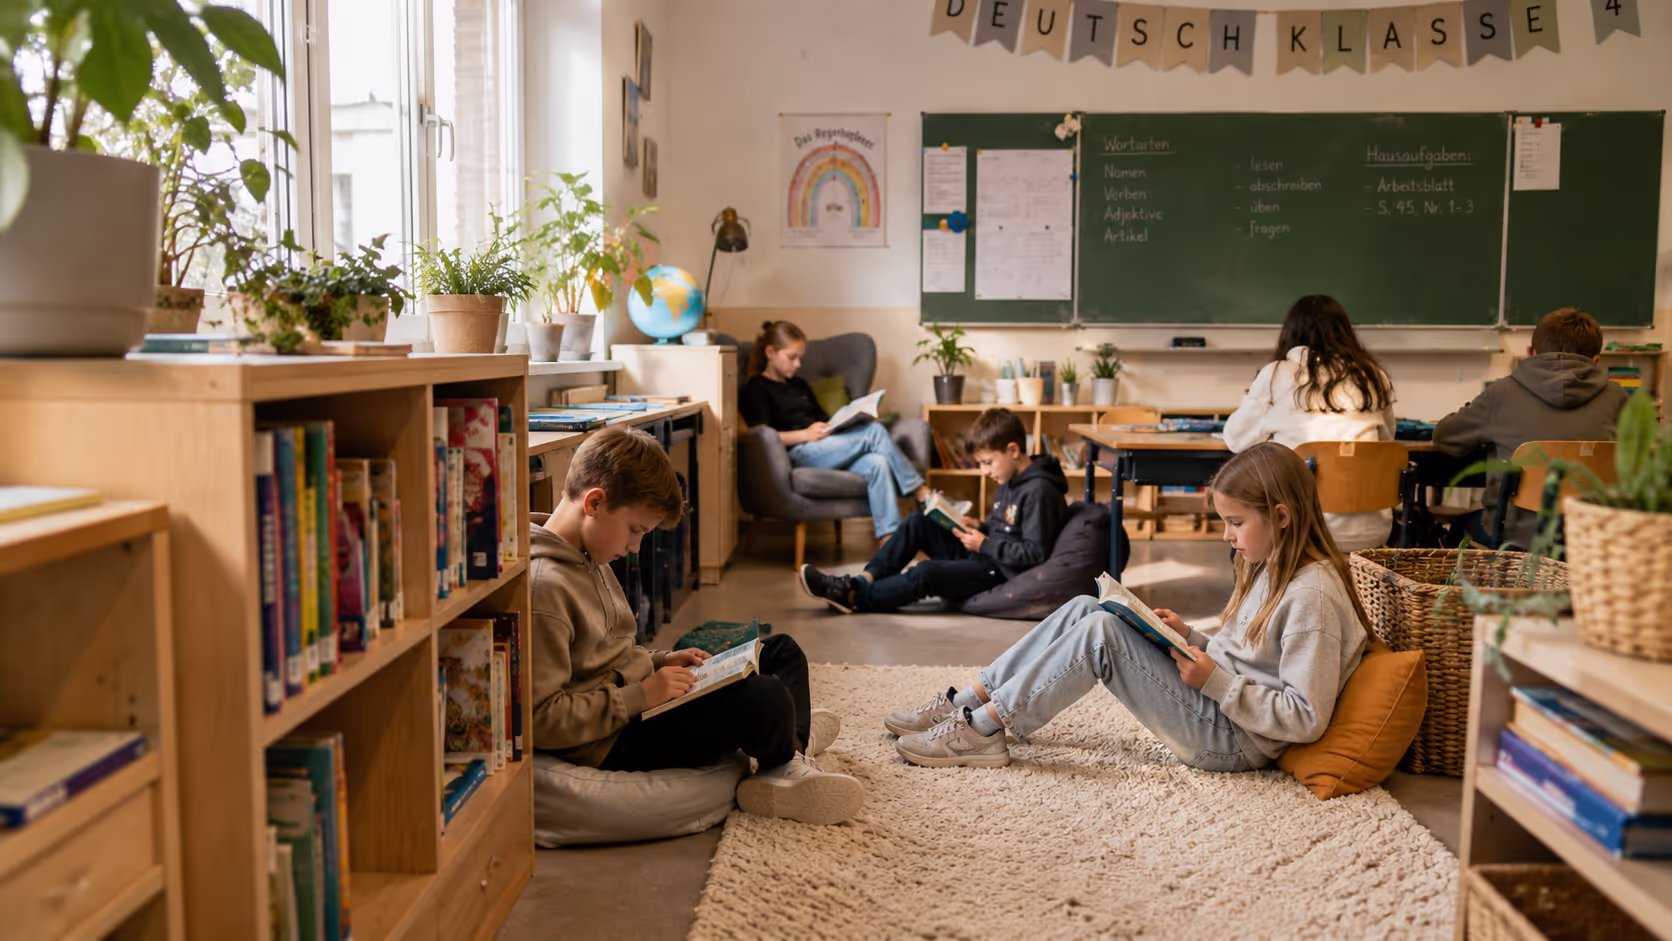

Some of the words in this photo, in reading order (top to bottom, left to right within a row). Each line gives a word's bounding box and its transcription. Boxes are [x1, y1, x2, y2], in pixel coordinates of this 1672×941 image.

[946, 0, 1241, 51] DEUTSCH
[1290, 6, 1544, 52] KLASSE
[1605, 0, 1621, 16] 4
[1103, 135, 1170, 151] Wortarten
[1366, 144, 1472, 171] Hausaufgaben:
[1104, 184, 1147, 201] Verben
[1377, 176, 1455, 193] Arbeitsblatt
[1104, 205, 1164, 226] Adjektive
[1424, 199, 1443, 216] Nr.
[1104, 226, 1148, 242] Artikel
[1250, 220, 1290, 240] fragen
